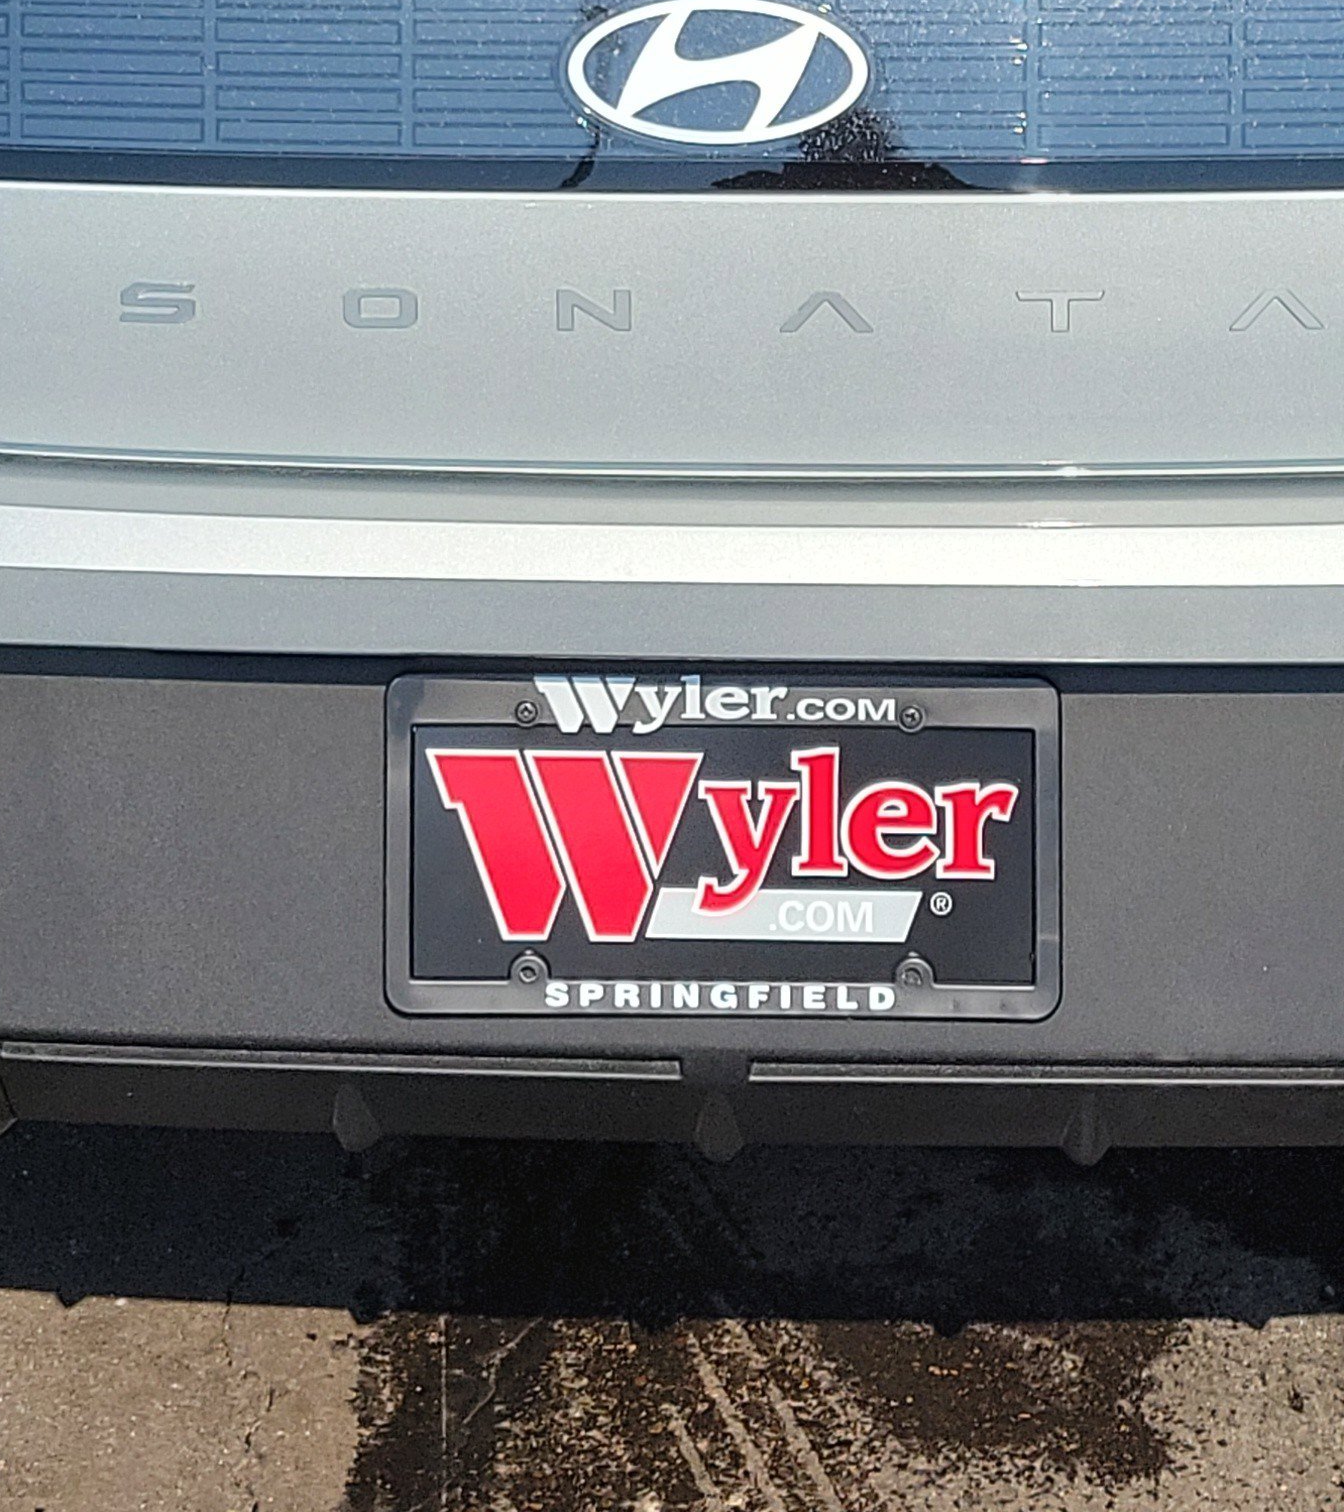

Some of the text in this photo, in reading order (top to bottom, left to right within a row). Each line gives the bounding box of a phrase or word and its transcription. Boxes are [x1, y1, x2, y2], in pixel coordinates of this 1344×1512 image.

[119, 281, 1325, 332] SONATA
[425, 746, 1018, 943] Wyler
[768, 900, 873, 933] .COM
[545, 982, 895, 1011] SPRINGFIELD
